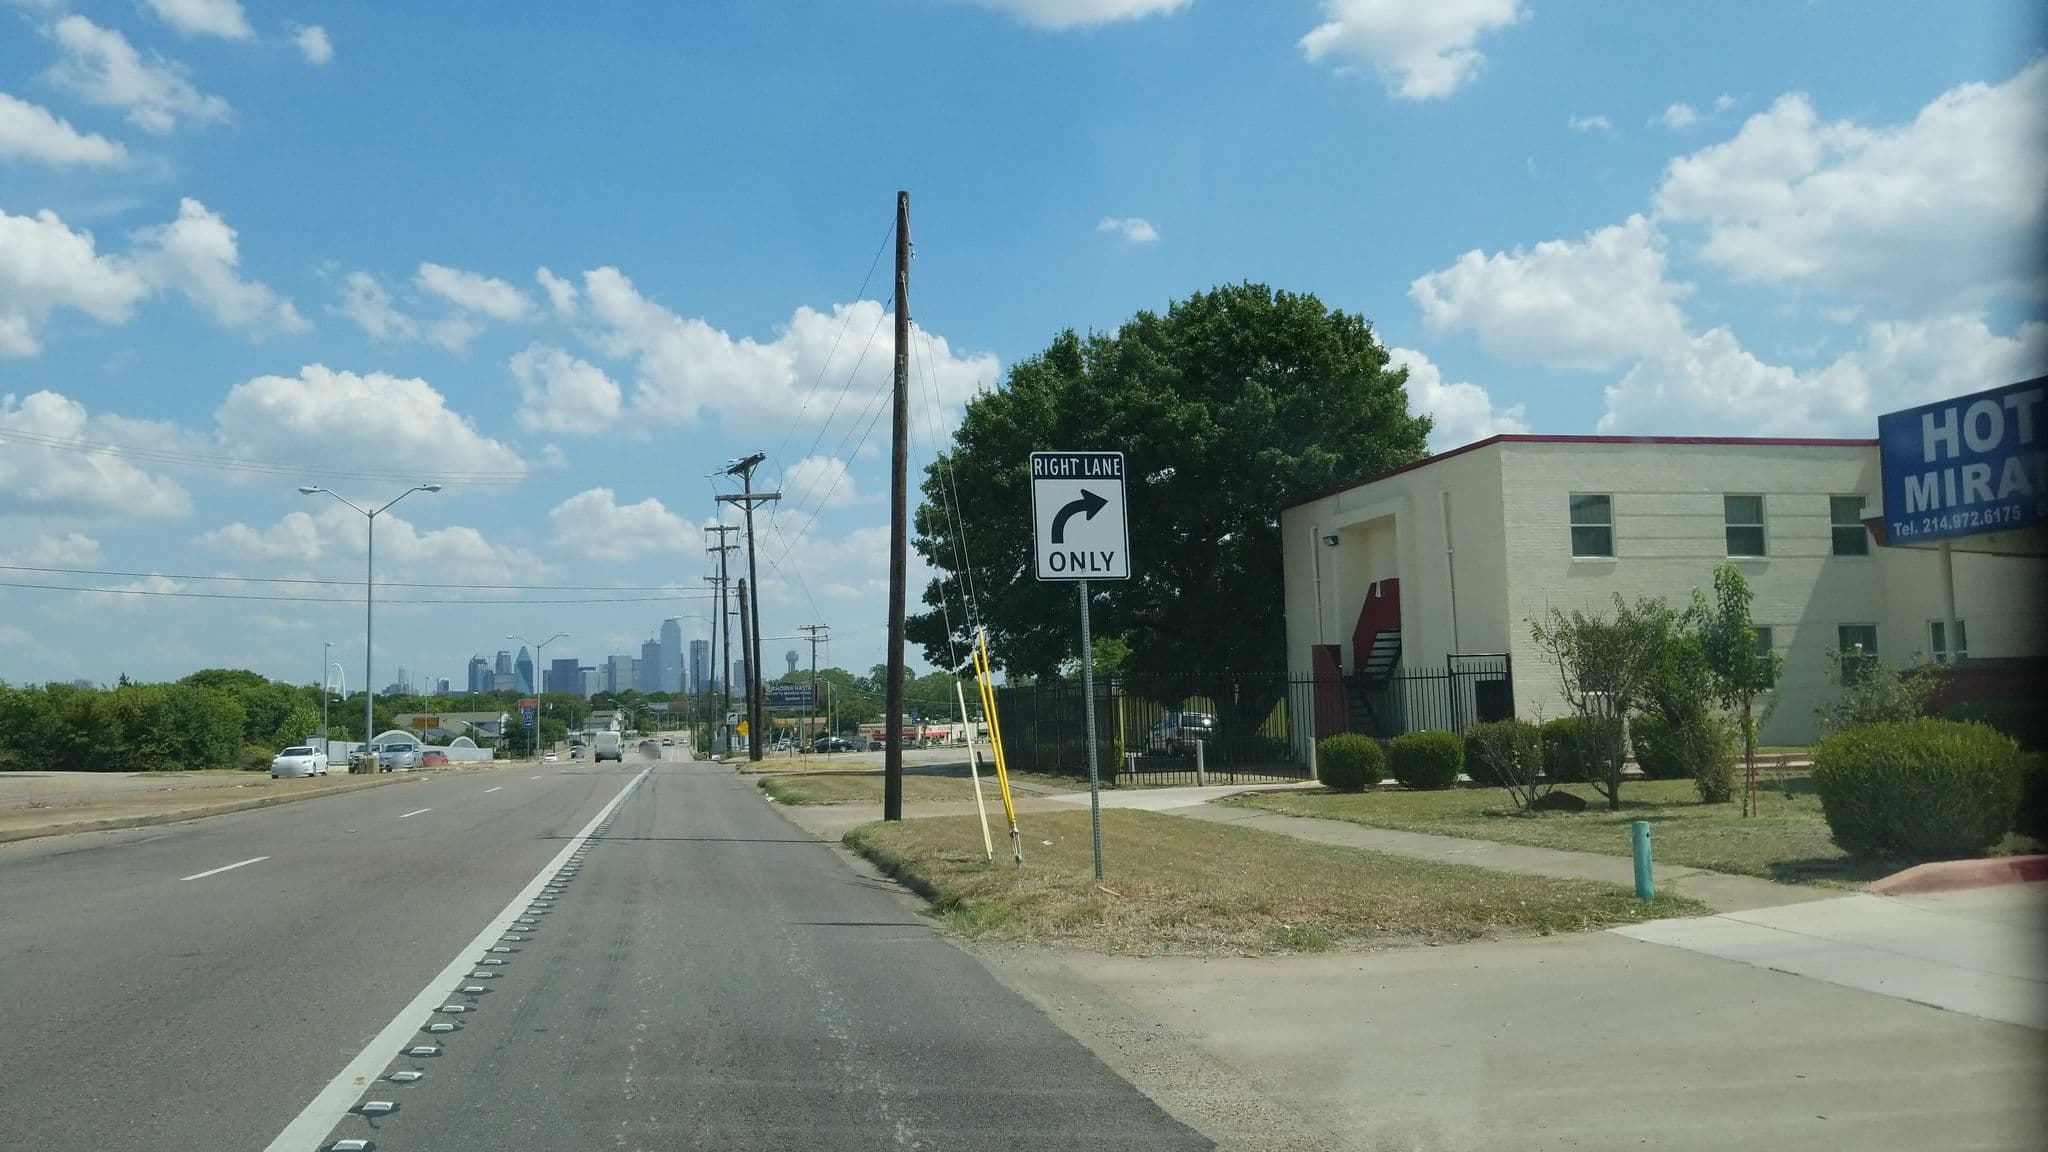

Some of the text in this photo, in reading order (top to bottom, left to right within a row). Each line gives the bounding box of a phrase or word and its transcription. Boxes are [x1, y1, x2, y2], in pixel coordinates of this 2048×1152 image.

[1921, 388, 2043, 462] HOT
[1034, 458, 1121, 476] RIGHT LANE
[1904, 452, 2045, 513] MIRA
[1893, 521, 1918, 537] Tel.
[1922, 504, 2021, 534] 214.972.6175
[1048, 551, 1115, 572] ONLY
